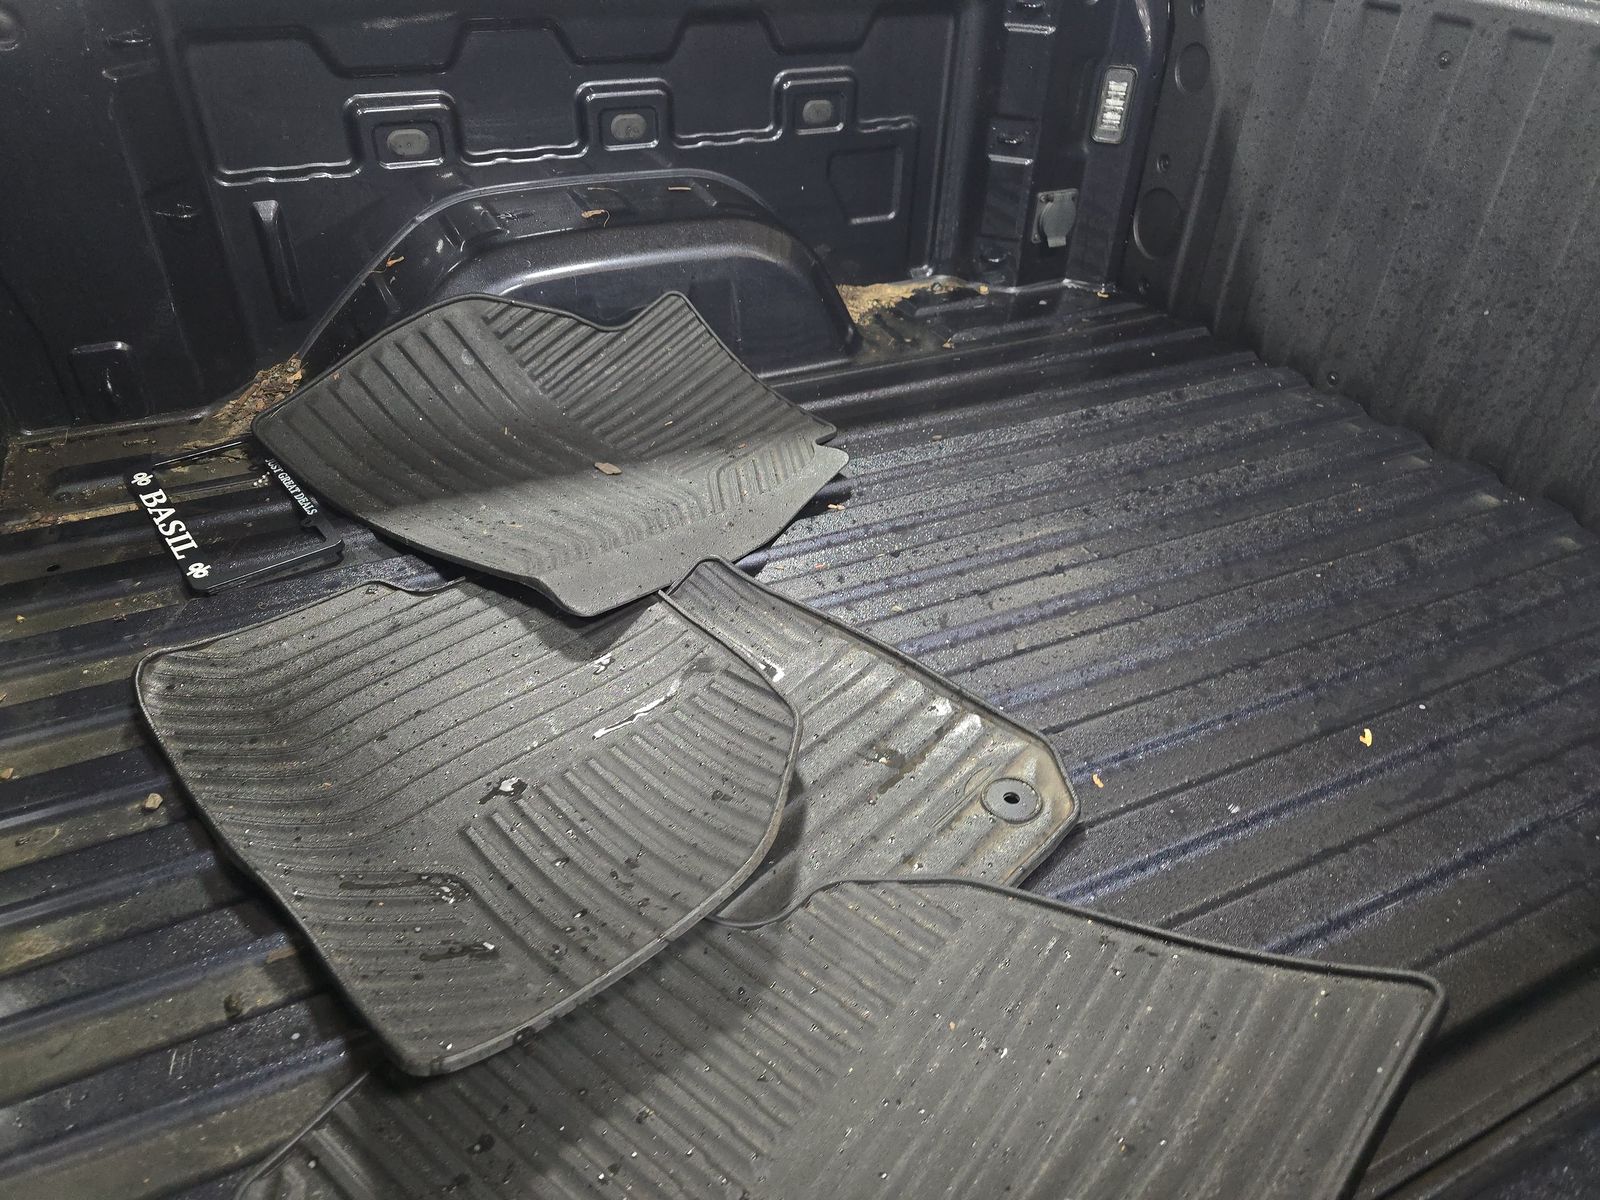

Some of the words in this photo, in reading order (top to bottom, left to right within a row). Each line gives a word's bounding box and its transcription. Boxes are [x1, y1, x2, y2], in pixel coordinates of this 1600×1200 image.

[278, 472, 301, 494] GREAT
[294, 492, 318, 515] DEALS
[139, 488, 199, 560] BASIL
